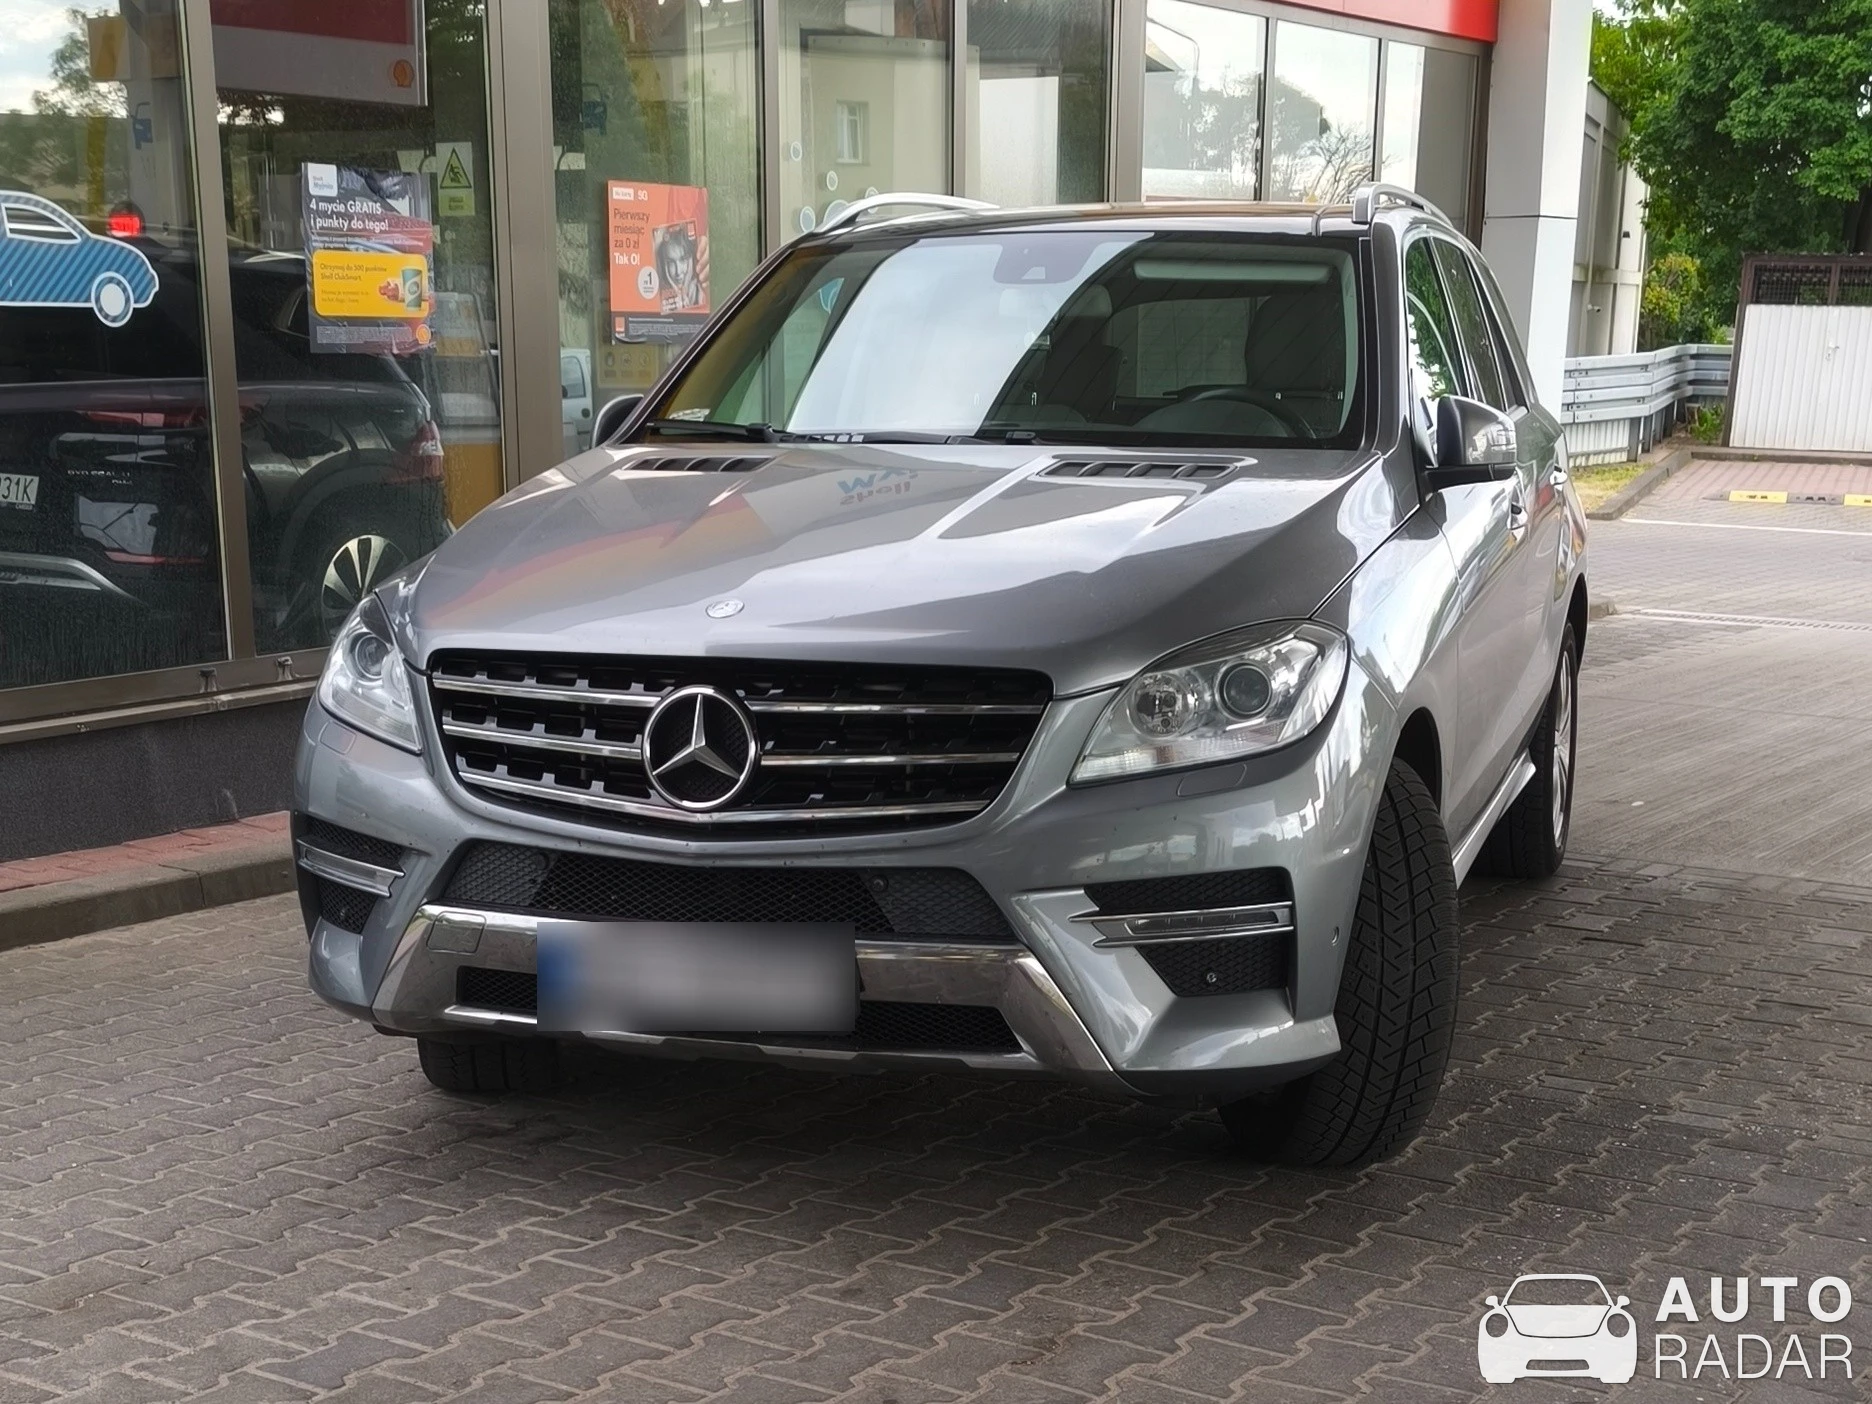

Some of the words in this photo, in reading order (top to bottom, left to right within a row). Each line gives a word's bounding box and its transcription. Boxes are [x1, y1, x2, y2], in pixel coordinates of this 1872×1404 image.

[309, 198, 316, 210] 4
[318, 200, 346, 214] mycie
[347, 200, 382, 214] GRATIS
[613, 208, 651, 223] Pierwszy
[316, 215, 349, 232] punkty
[351, 217, 363, 228] do
[365, 219, 389, 234] tego!
[614, 224, 645, 236] miesiąc
[614, 240, 624, 249] za
[625, 238, 632, 249] 0
[614, 252, 629, 265] Tak
[0, 475, 34, 502] 31K
